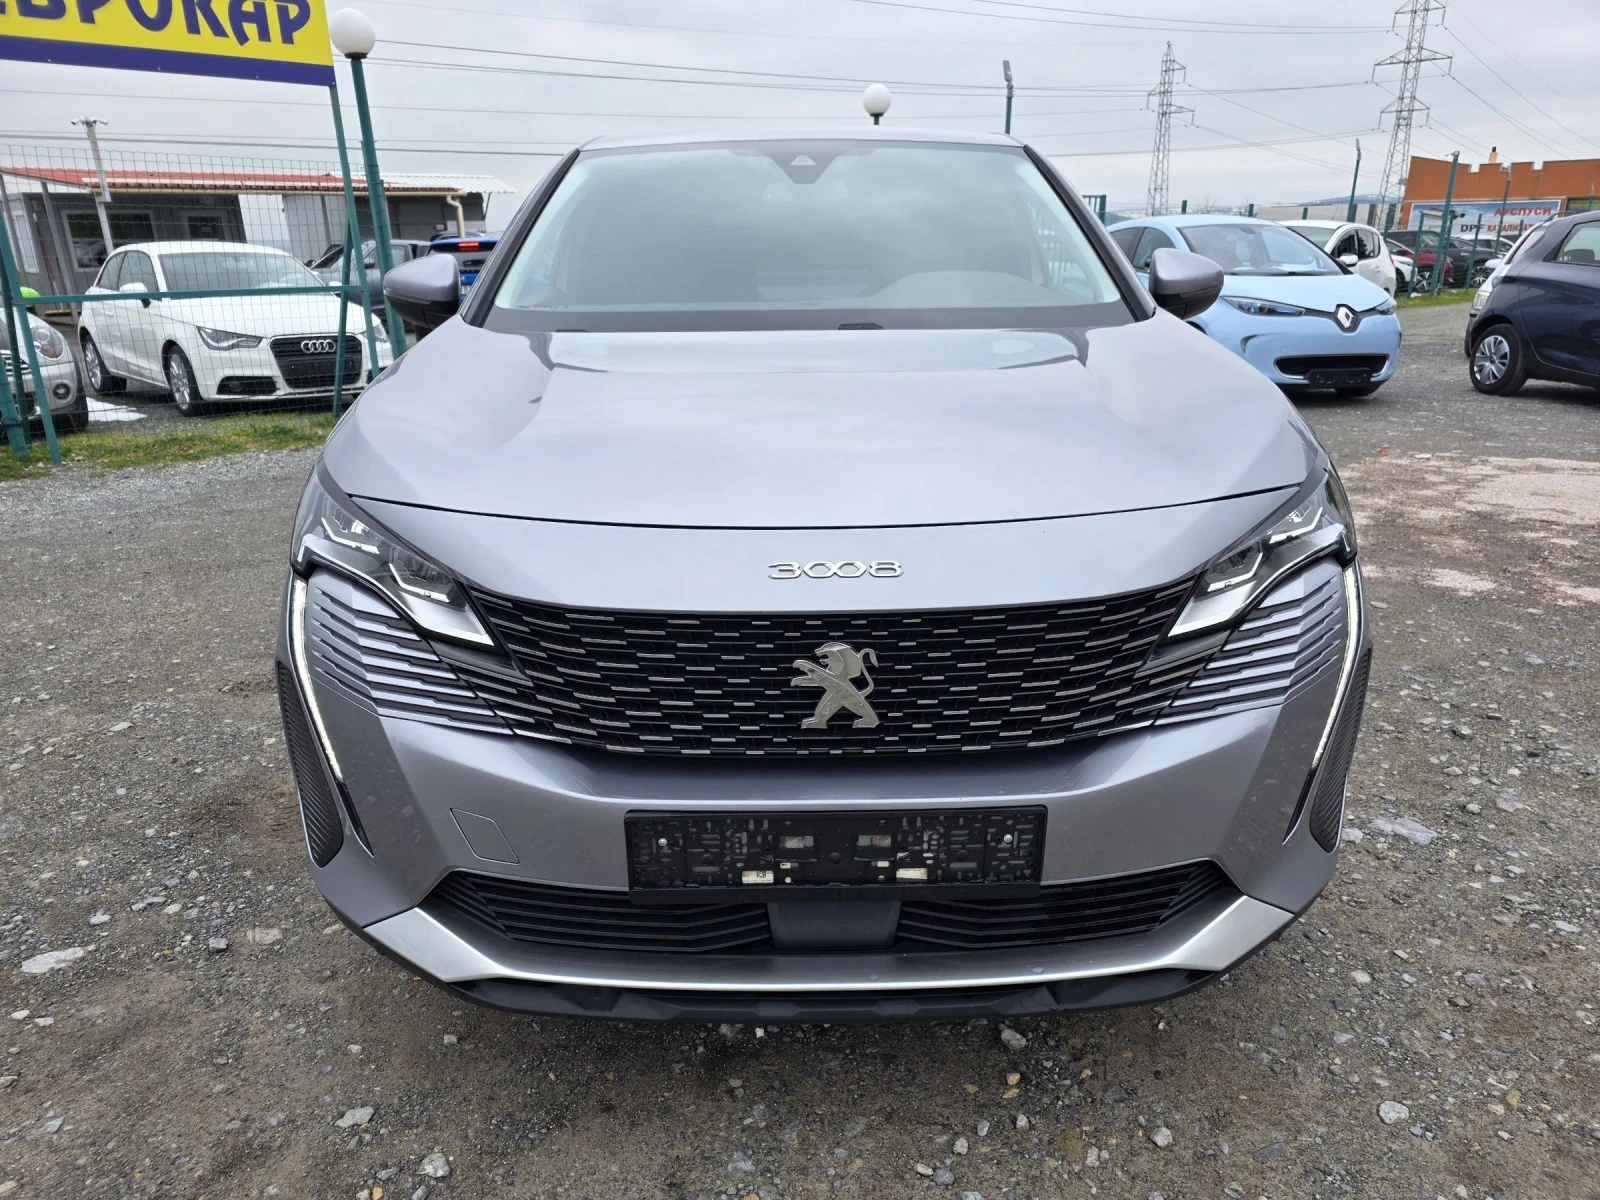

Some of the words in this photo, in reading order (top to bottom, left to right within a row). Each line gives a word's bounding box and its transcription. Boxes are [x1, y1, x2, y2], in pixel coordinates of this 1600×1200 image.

[0, 0, 311, 46] РОКАР
[1494, 207, 1552, 216] АУСПУСИ
[768, 561, 904, 579] 3008
